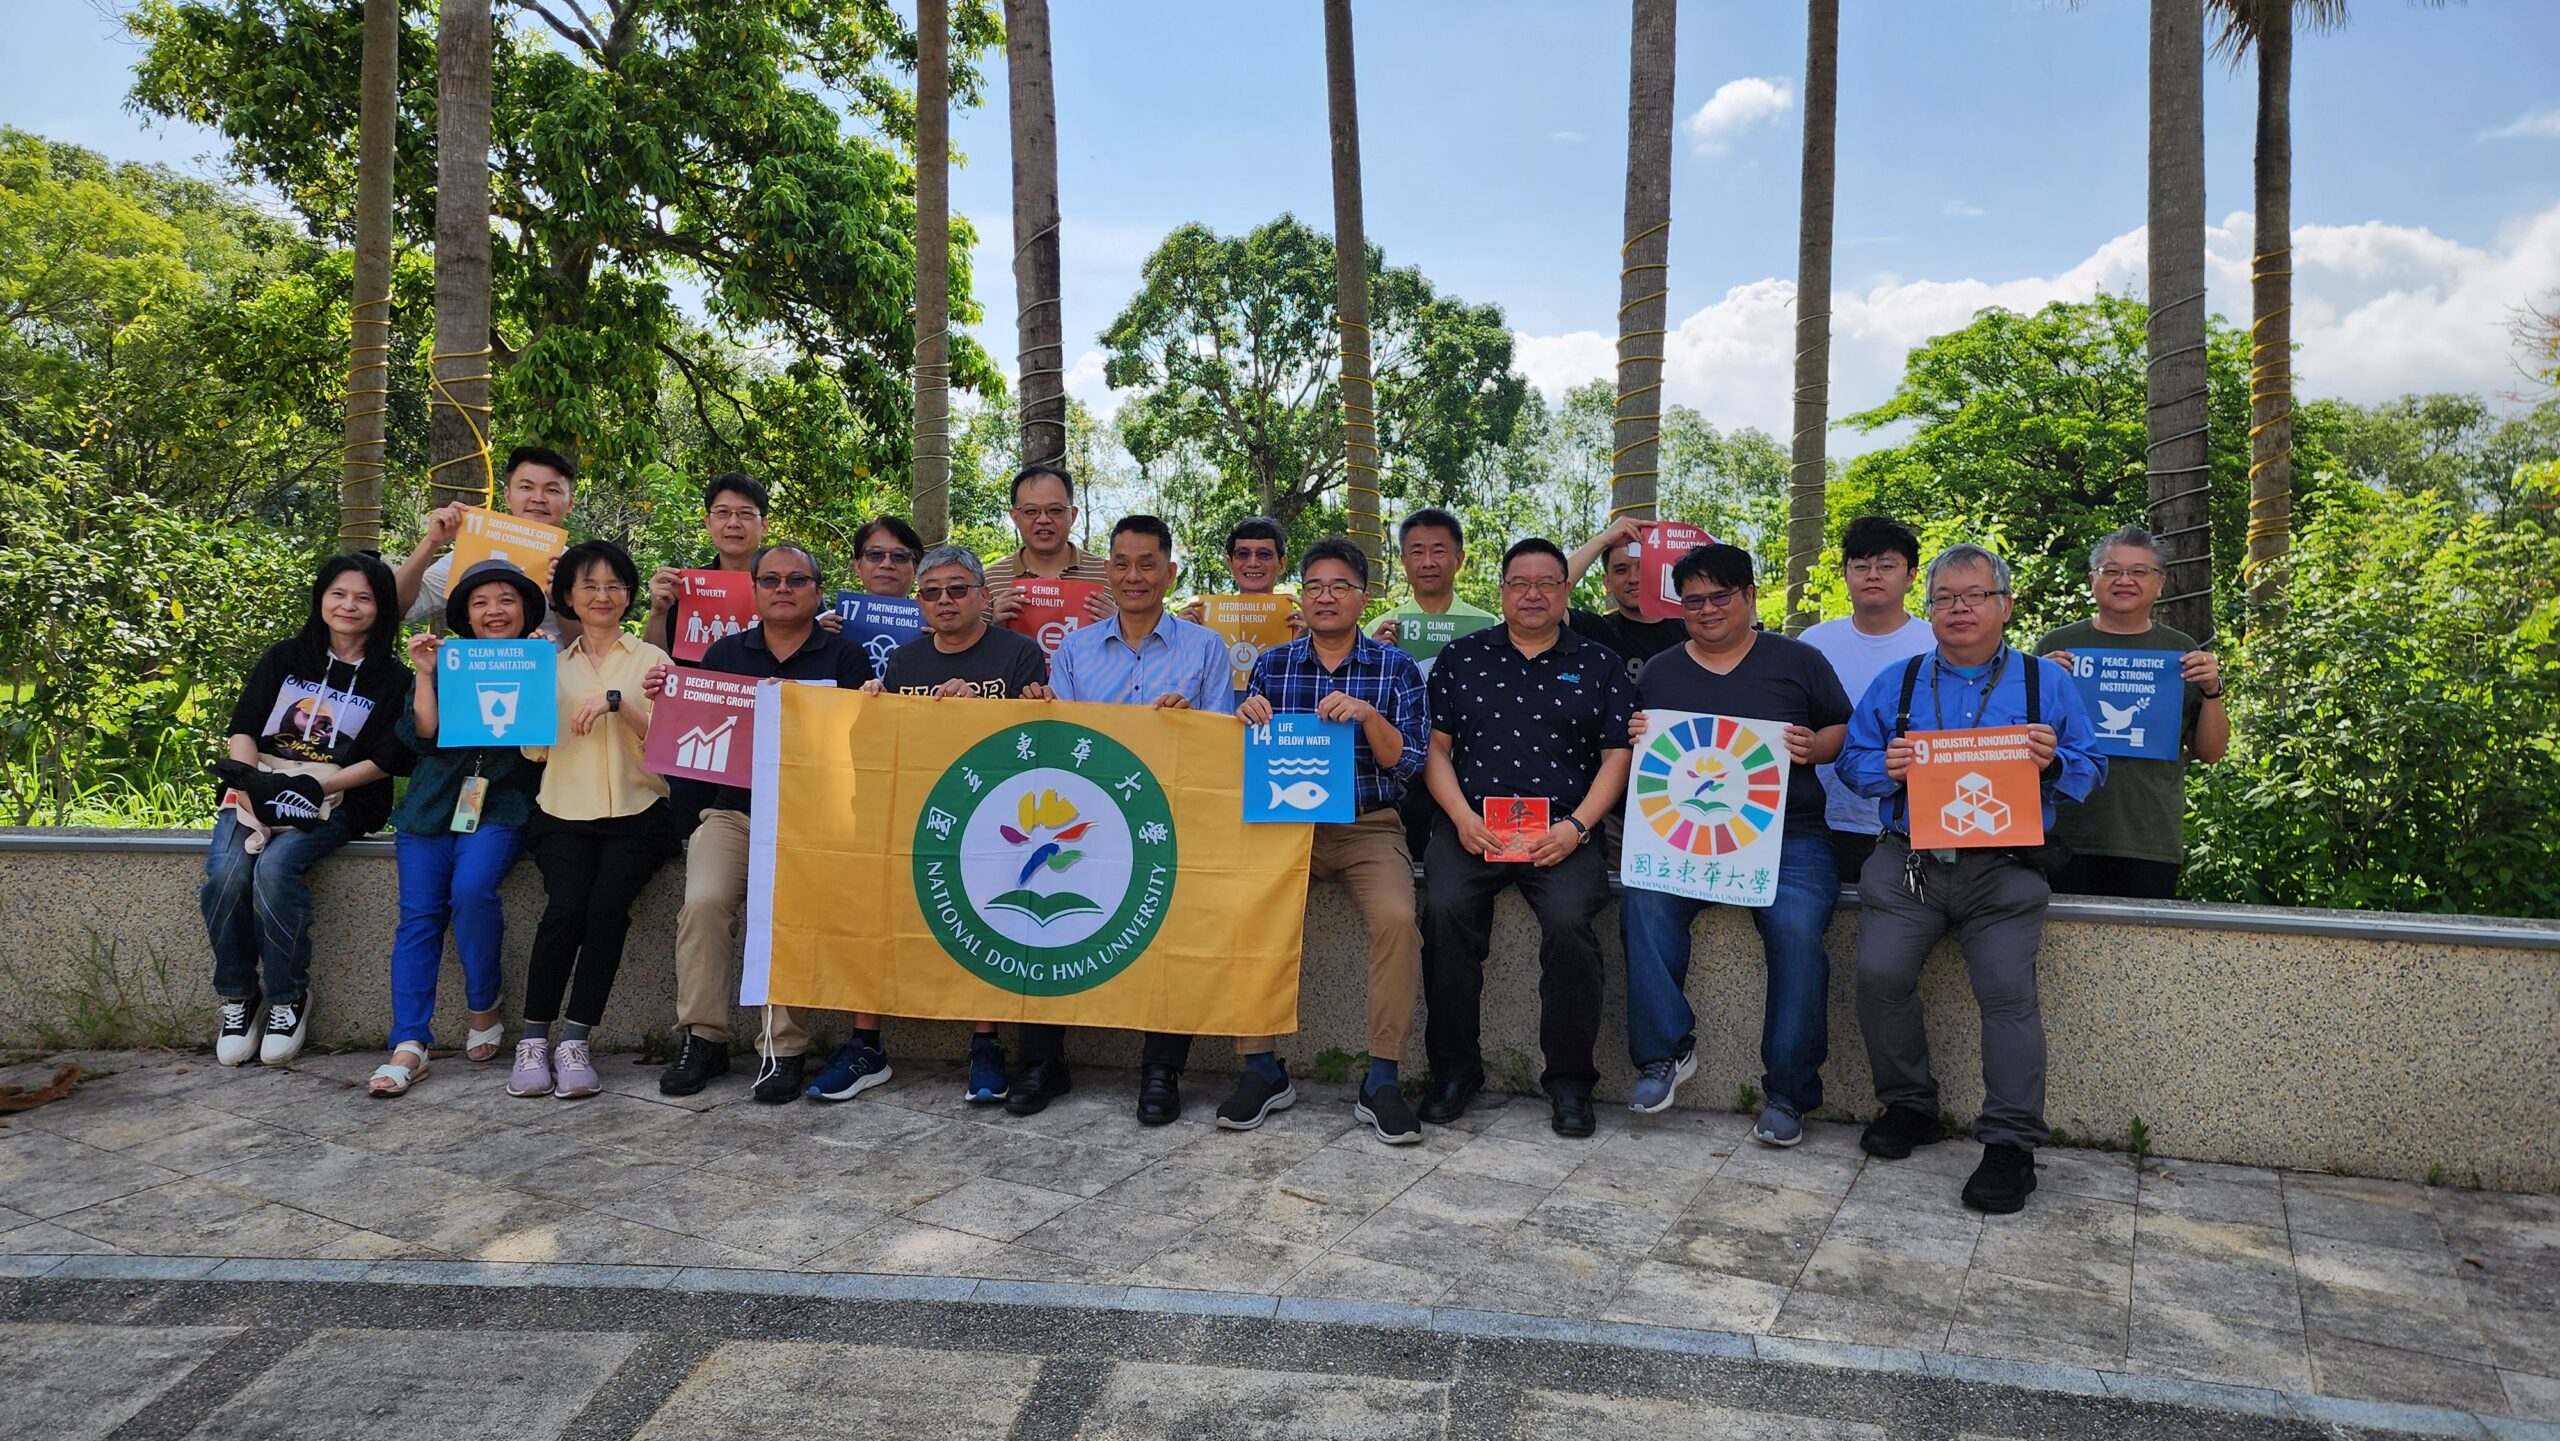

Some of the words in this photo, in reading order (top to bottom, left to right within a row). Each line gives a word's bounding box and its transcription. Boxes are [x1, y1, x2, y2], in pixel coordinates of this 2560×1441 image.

[466, 512, 484, 535] 11
[488, 519, 535, 537] SUSTAINABLE
[536, 530, 559, 542] CITIES
[485, 530, 501, 540] AND
[501, 533, 551, 552] COMMUNITIES
[1648, 528, 1660, 549] 4
[1667, 528, 1697, 539] QUALITY
[682, 577, 691, 595] 1
[695, 577, 705, 585] NO
[696, 588, 727, 598] POVERTY
[1032, 585, 1060, 595] GENDER
[841, 600, 860, 621] 17
[867, 602, 920, 616] PARTNERSHIPS
[1032, 598, 1064, 607] EQUALITY
[1218, 602, 1260, 611] AFFORDABLE
[1261, 602, 1276, 611] AND
[866, 614, 880, 624] FOR
[881, 615, 895, 625] THE
[895, 617, 918, 628] GOALS
[1218, 614, 1239, 622] CLEAN
[1241, 614, 1267, 623] ENERGY
[1427, 621, 1455, 631] CLIMATE
[1401, 620, 1421, 640] 13
[1426, 633, 1452, 642] ACTION
[446, 648, 460, 670] 6
[468, 648, 494, 657] CLEAN
[497, 648, 524, 657] WATER
[468, 661, 486, 670] AND
[488, 661, 536, 670] SANITATION
[2071, 655, 2094, 678] 16
[2102, 656, 2130, 668] PEACE,
[2131, 657, 2165, 669] JUSTICE
[2100, 669, 2118, 679] AND
[2120, 670, 2154, 681] STRONG
[664, 673, 679, 697] 8
[685, 676, 715, 690] DECENT
[716, 680, 740, 693] WORK
[740, 685, 757, 696] AND
[2099, 682, 2156, 694] INSTITUTIONS
[683, 689, 725, 704] ECONOMIC
[726, 695, 756, 709] GROWT
[1250, 720, 1272, 745] 14
[1278, 723, 1294, 732] LIFE
[1278, 735, 1305, 746] BELOW
[1305, 735, 1331, 746] WATER
[1932, 737, 1977, 749] INDUSTRY,
[1978, 733, 2030, 747] INNOVATION
[1914, 739, 1930, 765] 9
[1933, 752, 1952, 764] AND
[1953, 748, 2031, 763] INFRASTRUCTURE
[1629, 852, 1771, 895] 國立東華大學
[1629, 879, 1670, 891] NATIONAL
[1671, 886, 1698, 896] DONG
[1699, 890, 1719, 900] HWA
[1721, 893, 1767, 905] UNIVERSITY
[926, 861, 984, 957] NATIONAL
[985, 947, 1045, 981] DONG
[1052, 955, 1099, 981] HWA
[1099, 862, 1168, 965] UNIVERSITY
